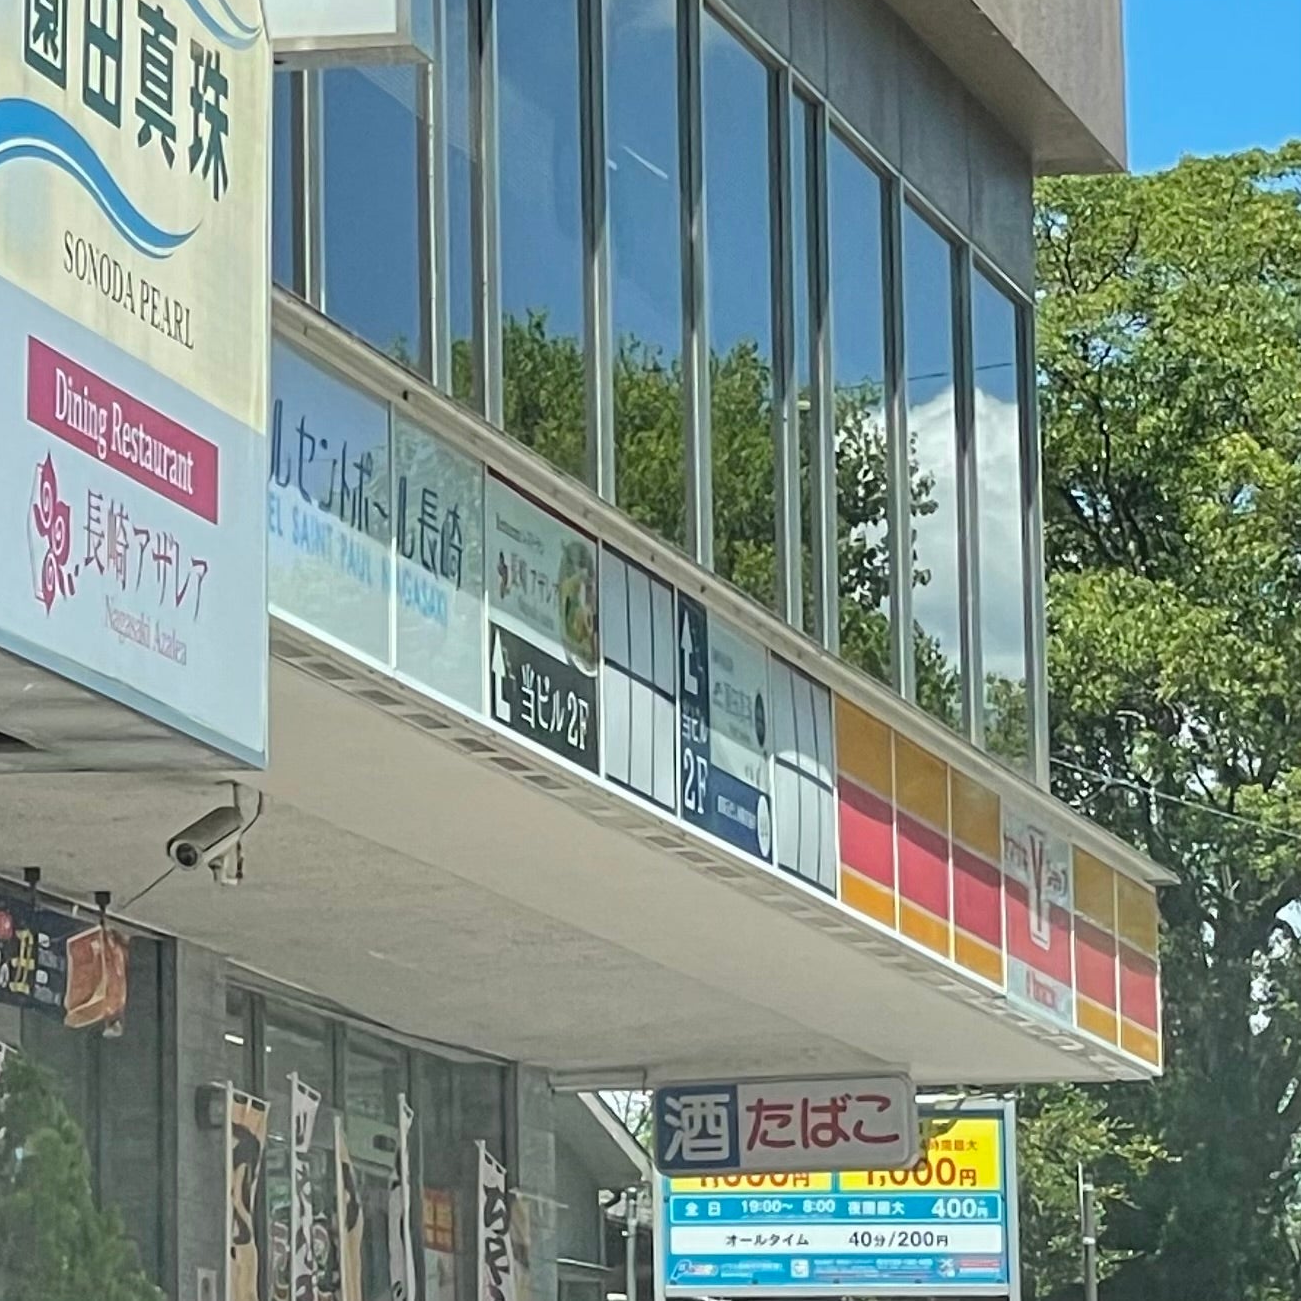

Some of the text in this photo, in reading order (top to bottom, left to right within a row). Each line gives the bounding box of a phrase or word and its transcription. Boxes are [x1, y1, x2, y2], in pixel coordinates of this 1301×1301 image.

[63, 230, 195, 350] SONODA PEARL
[54, 368, 194, 495] Dining Restaurant
[84, 489, 208, 622] 長崎アザレア
[663, 1092, 899, 1163] 酒 たばこ
[726, 1231, 949, 1248] オールタイム 40分/200円
